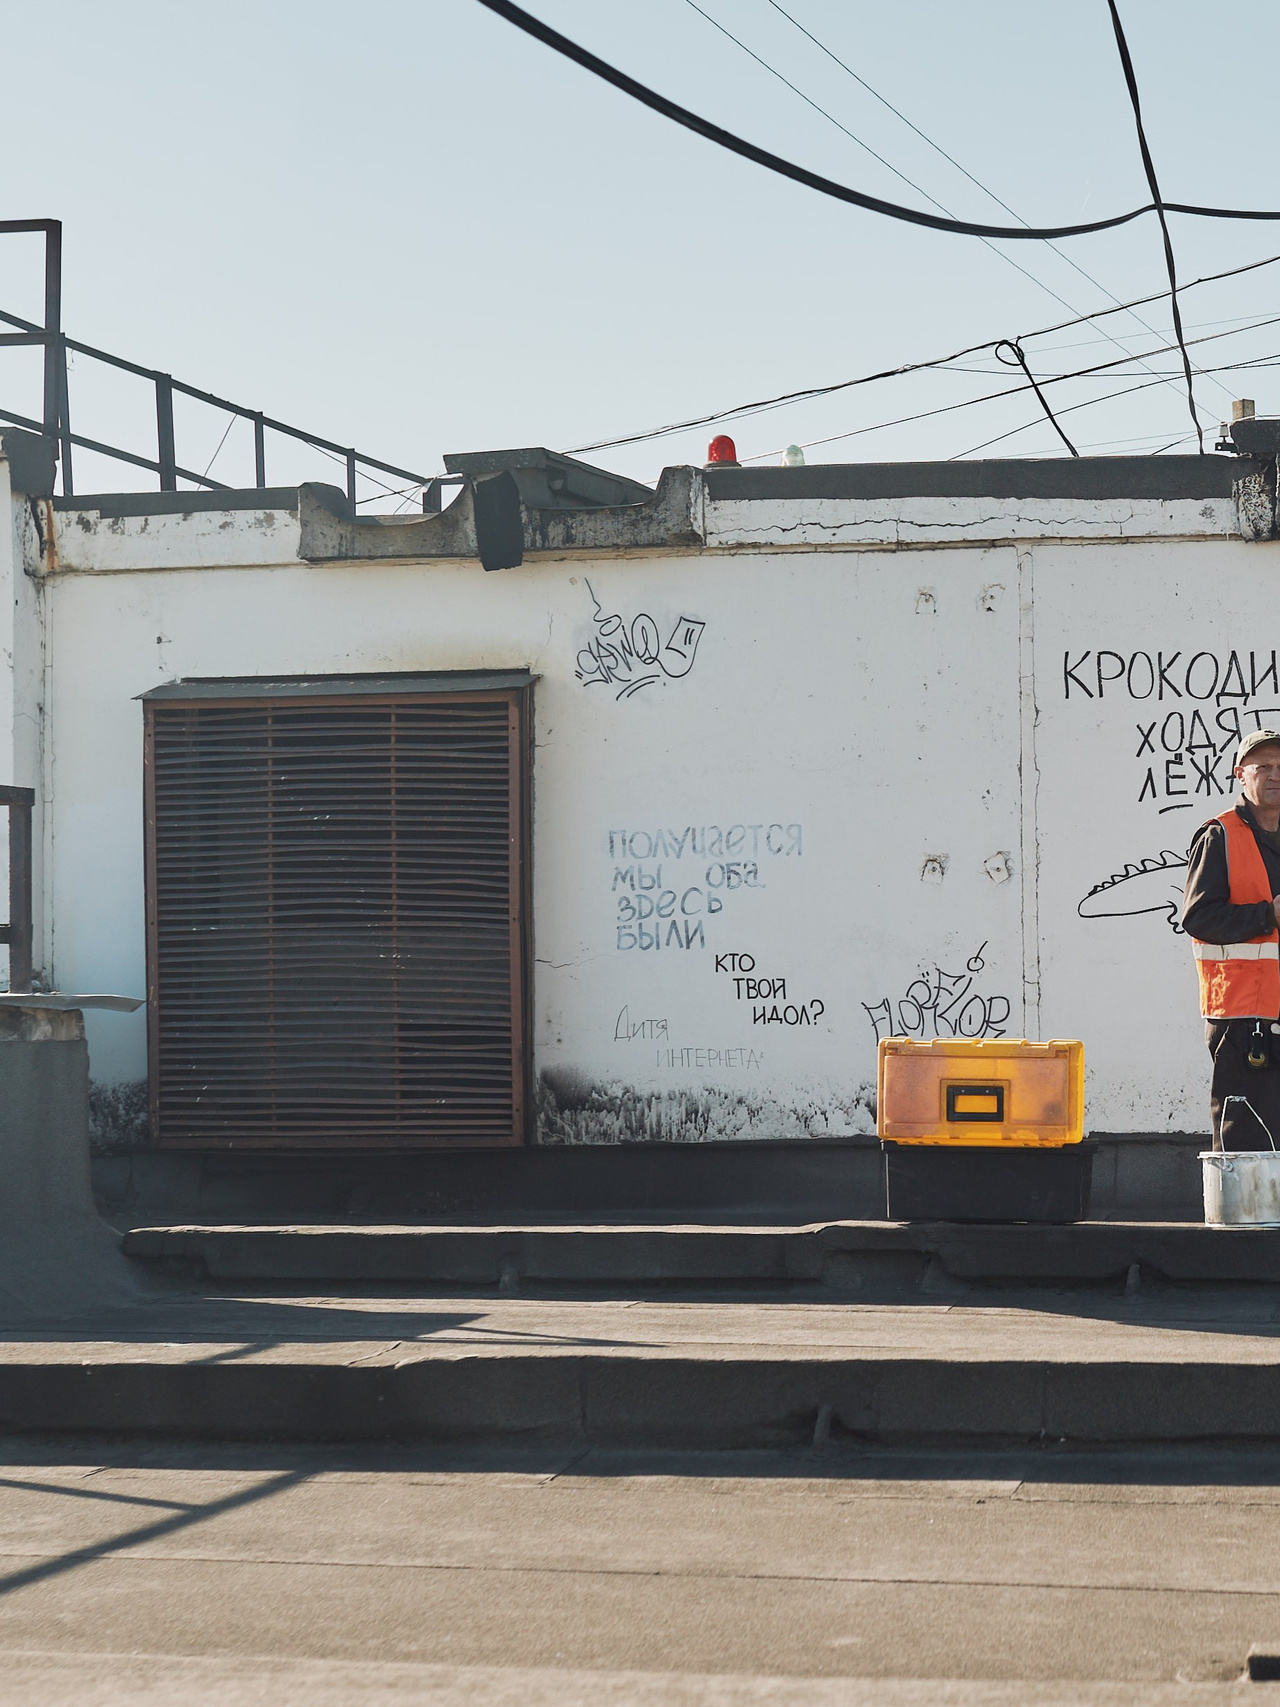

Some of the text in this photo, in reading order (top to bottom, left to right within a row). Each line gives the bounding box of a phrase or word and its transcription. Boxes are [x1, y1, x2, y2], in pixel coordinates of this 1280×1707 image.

[1136, 707, 1280, 757] ХОДЯТ
[611, 863, 662, 892] МЫ
[616, 919, 706, 951] БЫЛИ
[715, 953, 756, 973] КТО
[753, 999, 825, 1026] ИДОЛ?
